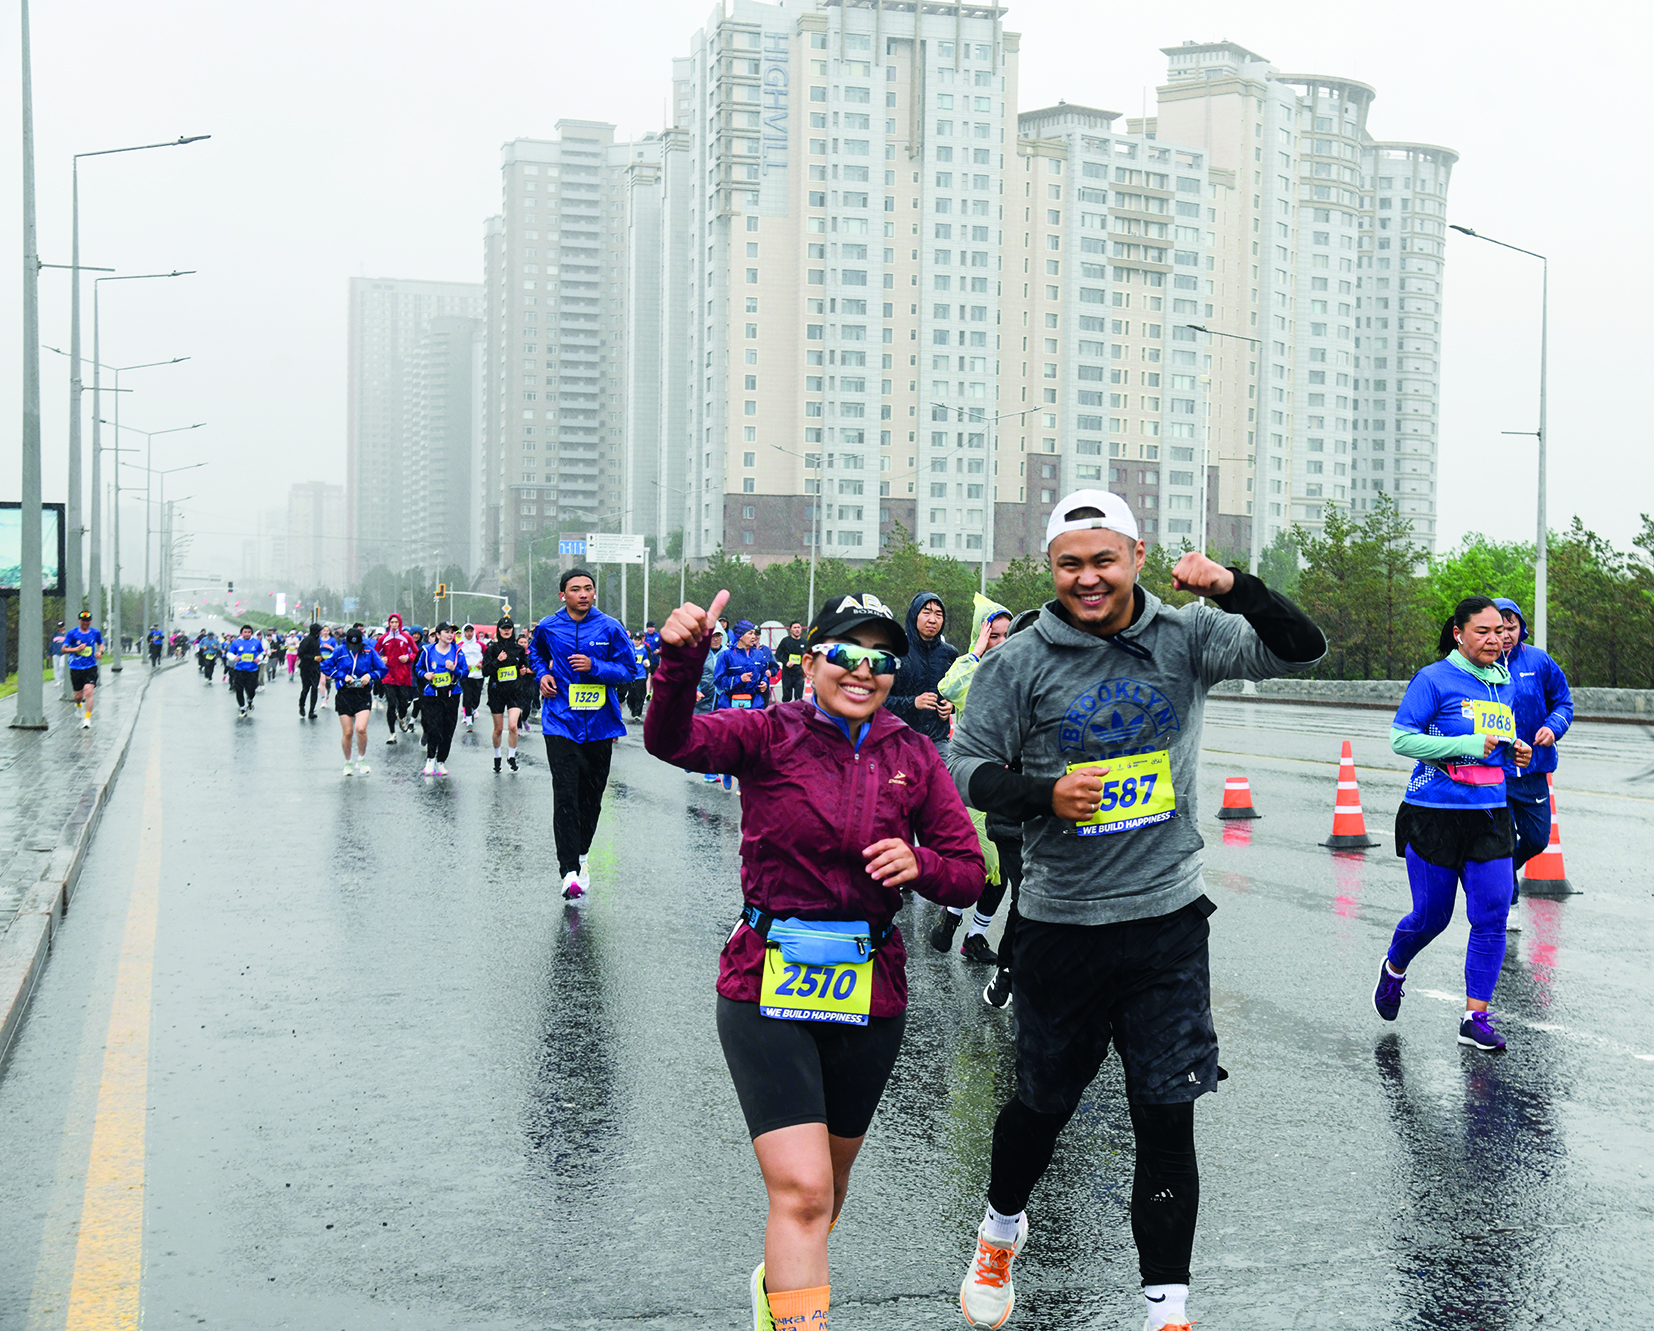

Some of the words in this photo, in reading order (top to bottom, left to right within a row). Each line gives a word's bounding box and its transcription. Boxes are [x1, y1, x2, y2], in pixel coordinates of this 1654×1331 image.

[763, 31, 789, 176] HIGHVILL
[853, 608, 885, 618] BOXIN
[575, 691, 600, 703] 1329
[1062, 681, 1174, 743] BROOKLYN
[1481, 712, 1512, 732] 1868
[1099, 773, 1158, 812] 587
[1082, 825, 1097, 835] WE
[1098, 821, 1125, 833] BUILD
[1125, 811, 1171, 829] HAPPINESS
[774, 964, 857, 1001] 2510
[766, 1007, 783, 1017] WE
[782, 1009, 811, 1019] BUILD
[811, 1011, 863, 1023] HAPPINESS
